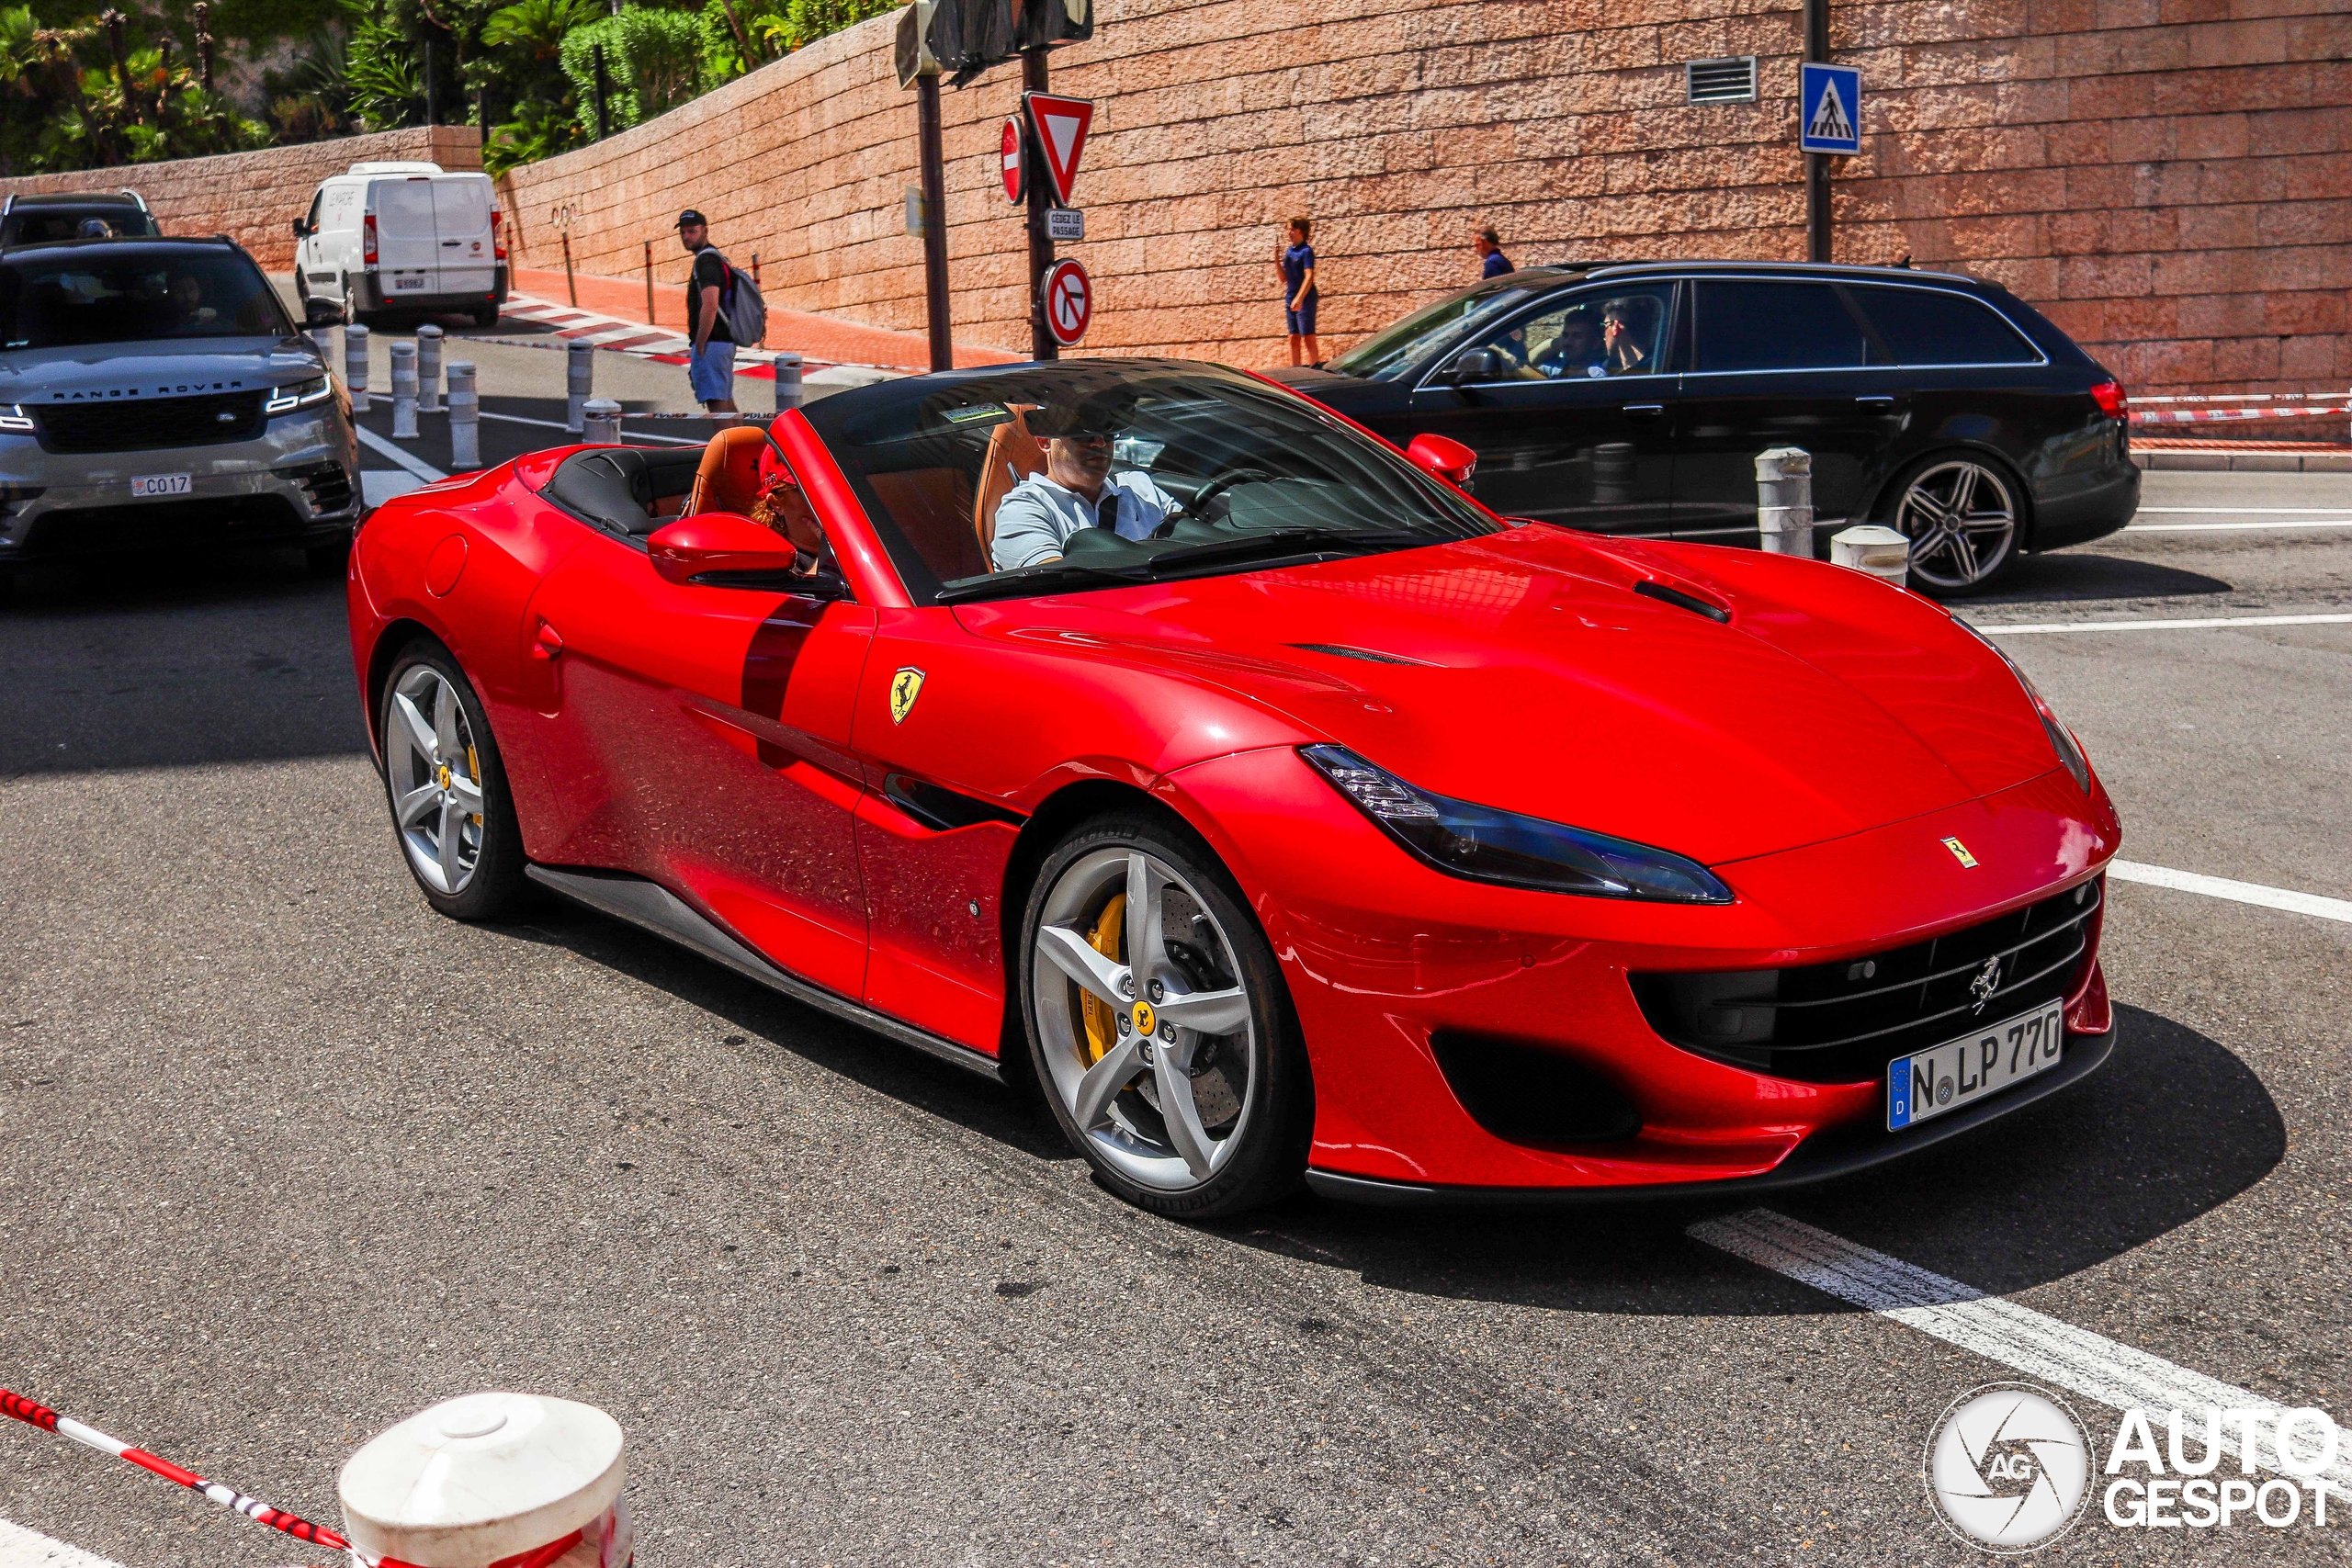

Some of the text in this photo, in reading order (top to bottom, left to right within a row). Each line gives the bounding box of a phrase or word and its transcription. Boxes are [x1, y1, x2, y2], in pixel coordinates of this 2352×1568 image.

[1051, 212, 1080, 224] CÉDEZ LE
[1052, 226, 1080, 236] PASSAGE
[53, 381, 243, 400] RANGE ROVER
[1912, 1010, 2060, 1113] N LP 770
[1895, 1100, 1905, 1115] D
